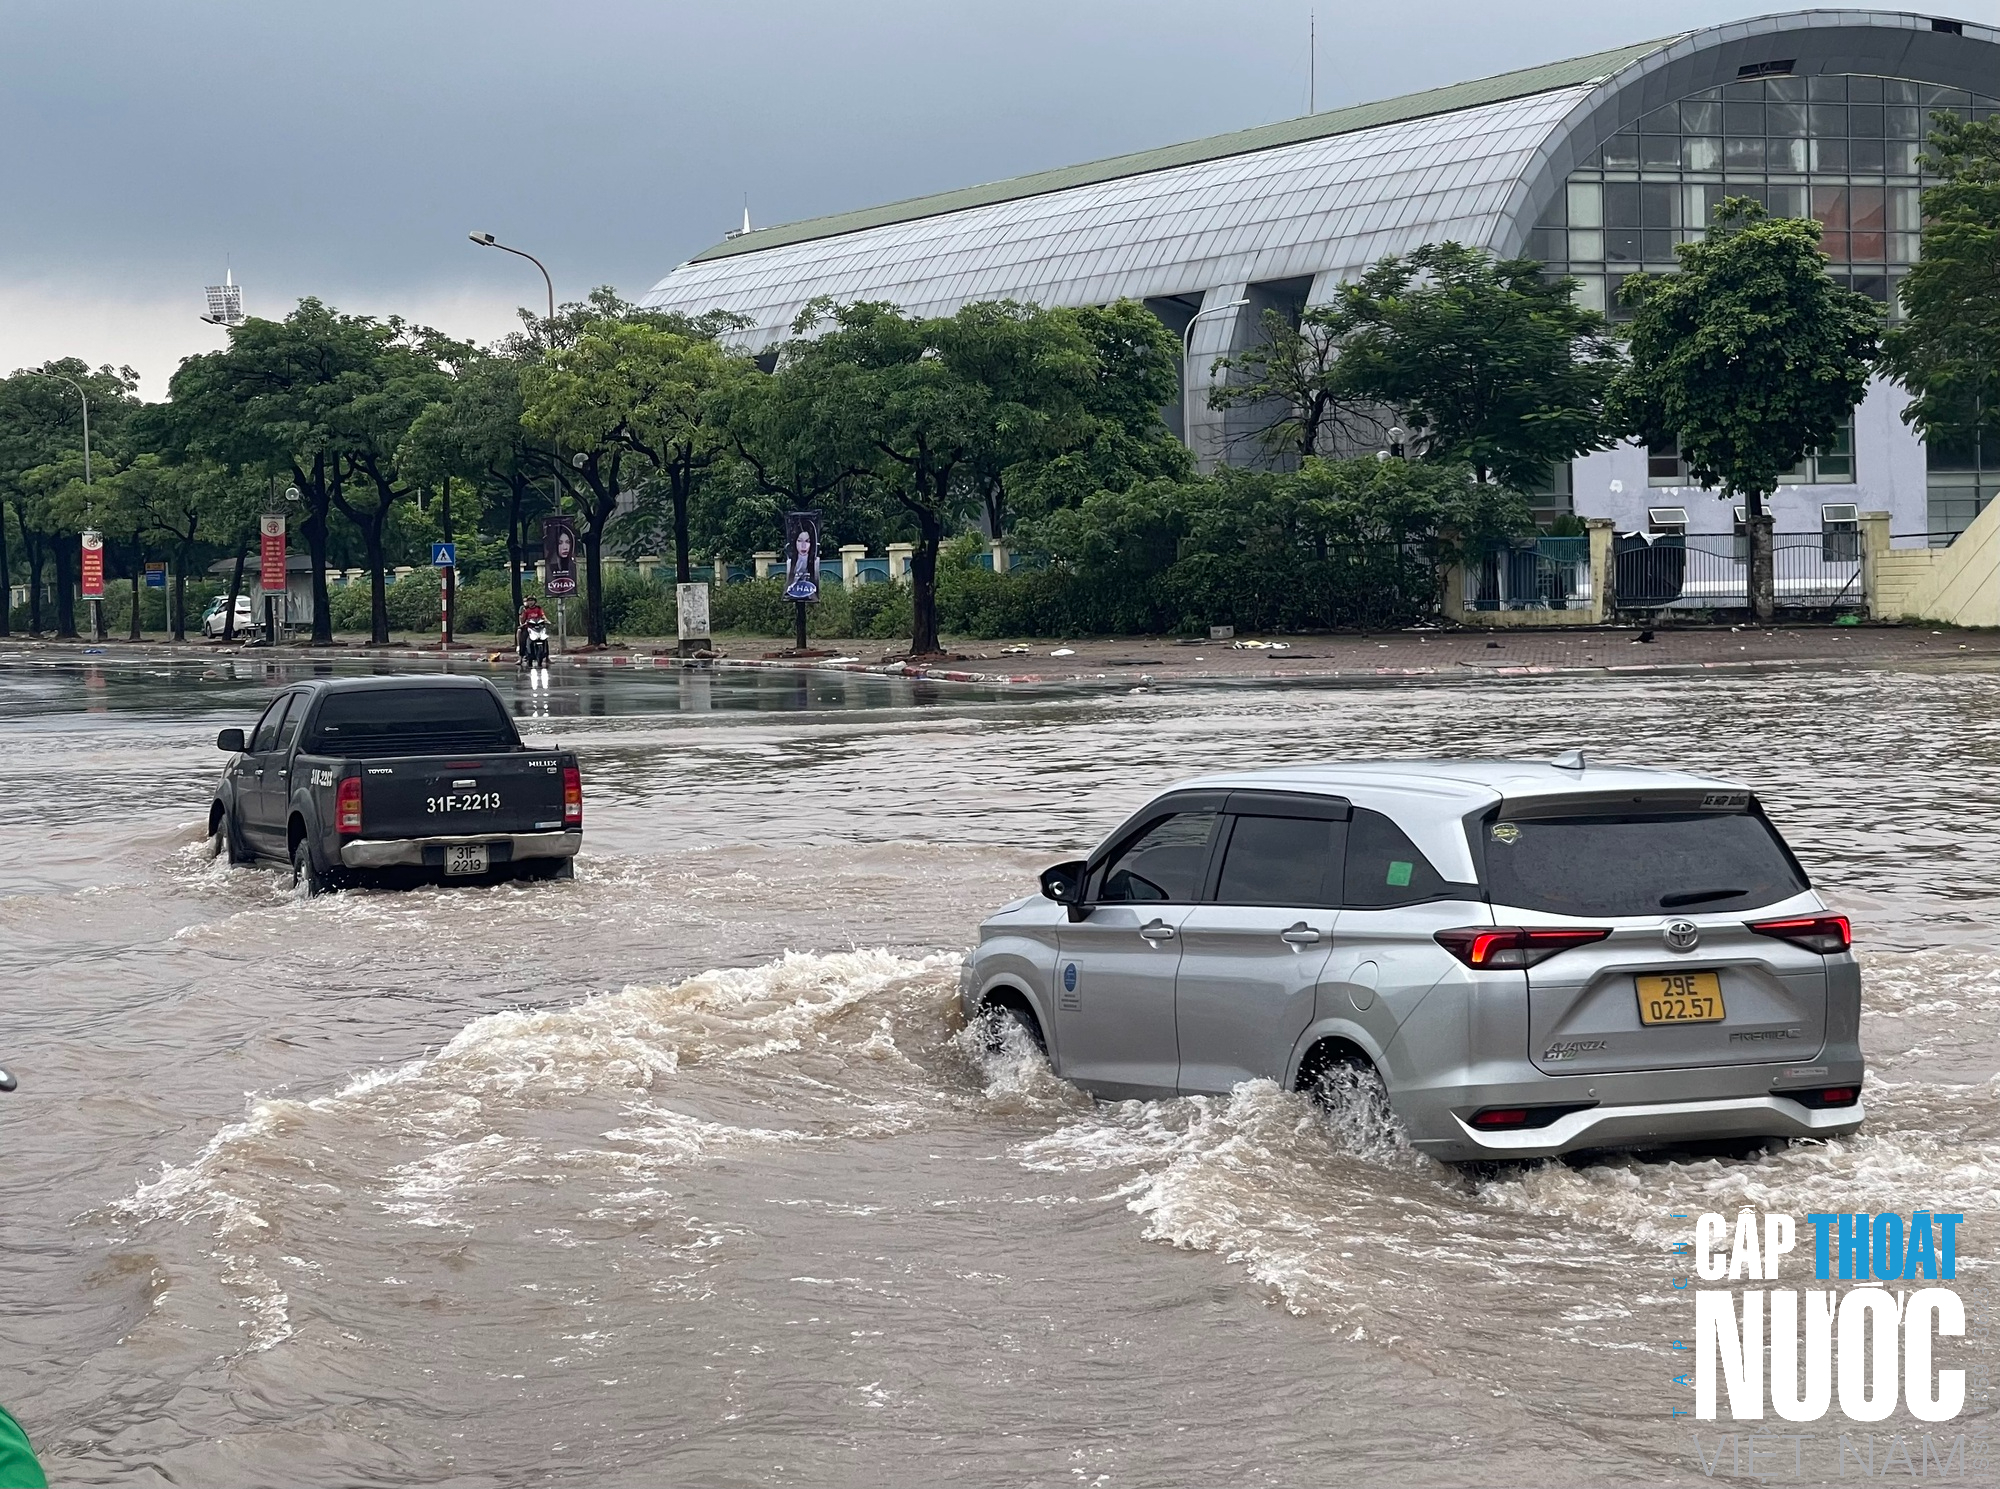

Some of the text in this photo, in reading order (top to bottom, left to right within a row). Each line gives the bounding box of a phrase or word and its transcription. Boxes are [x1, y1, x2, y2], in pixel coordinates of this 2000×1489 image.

[426, 792, 501, 813] 31F-2213
[456, 846, 477, 859] 31F
[452, 859, 481, 872] 2213
[1660, 975, 1698, 997] 29E
[1650, 997, 1713, 1020] 022.57
